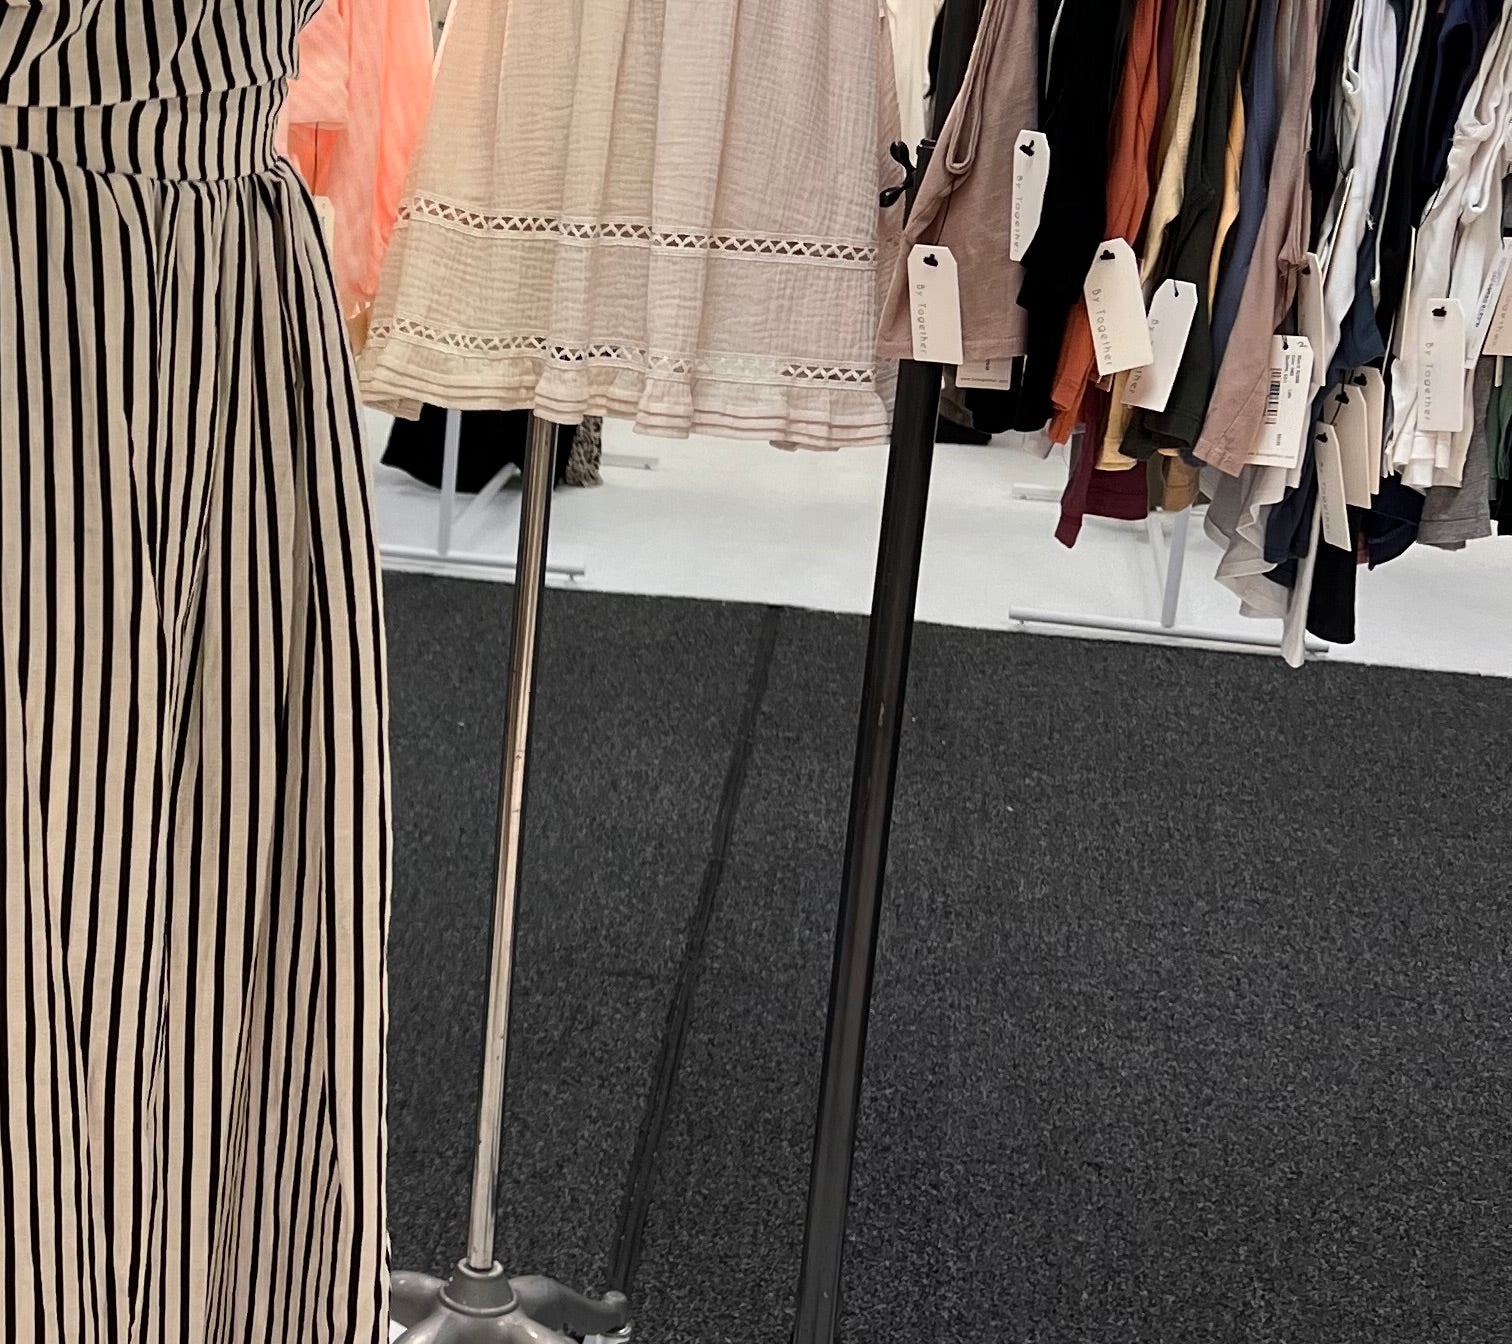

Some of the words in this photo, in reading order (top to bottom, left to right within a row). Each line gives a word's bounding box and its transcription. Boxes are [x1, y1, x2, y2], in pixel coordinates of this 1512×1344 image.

[916, 283, 926, 297] By
[1091, 288, 1102, 303] By
[917, 303, 929, 354] Together
[1096, 310, 1113, 366] Together
[1424, 342, 1434, 357] By
[1423, 364, 1434, 422] Together
